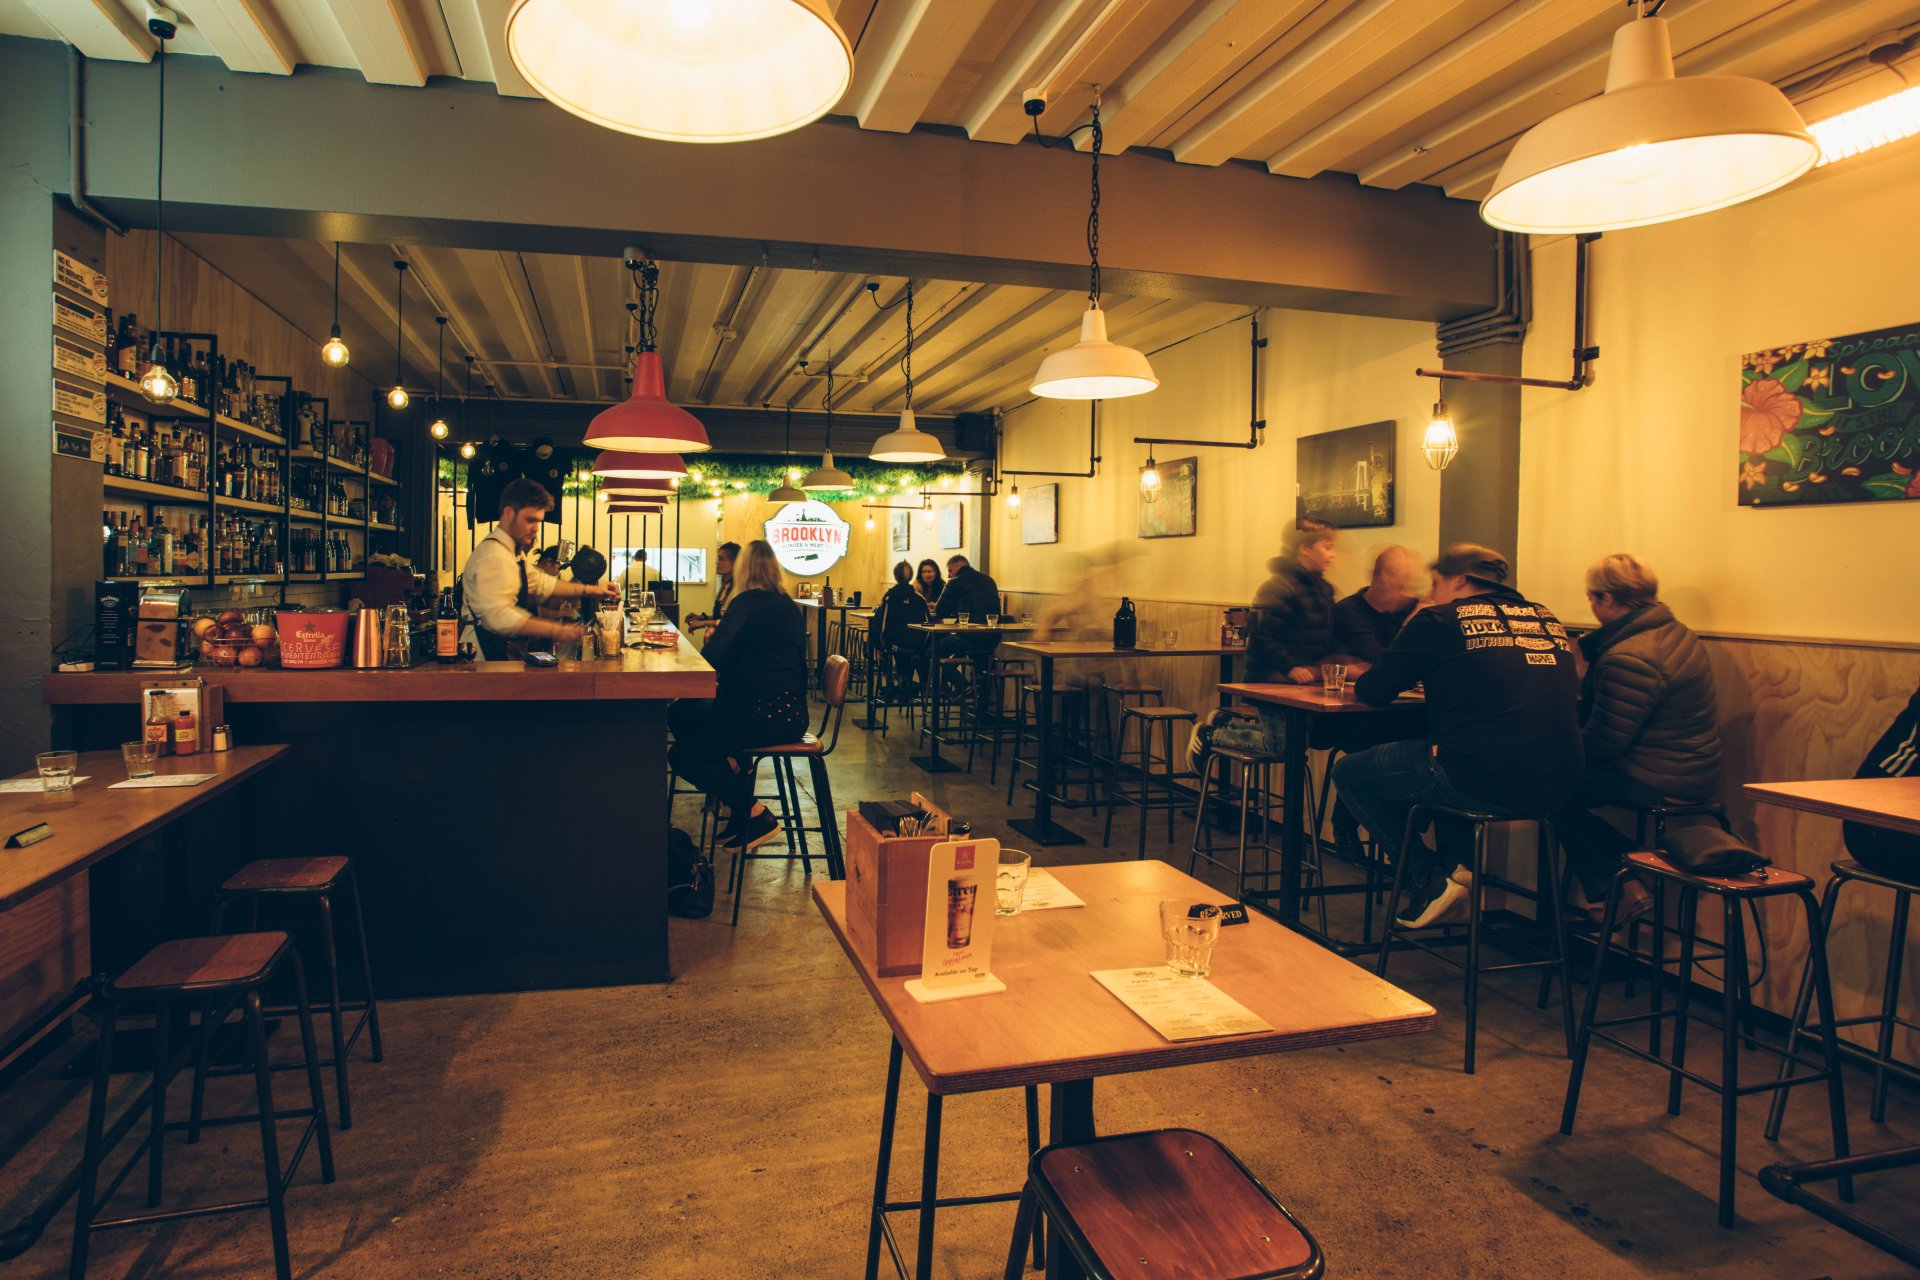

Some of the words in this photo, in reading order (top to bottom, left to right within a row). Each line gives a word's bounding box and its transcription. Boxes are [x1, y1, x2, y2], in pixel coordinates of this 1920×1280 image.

[772, 527, 842, 545] BROOKLYN
[296, 630, 325, 638] Estrella
[1461, 622, 1507, 635] HULK
[1466, 636, 1514, 650] ULTRON
[1527, 654, 1555, 664] MARVEL
[935, 969, 958, 977] Available
